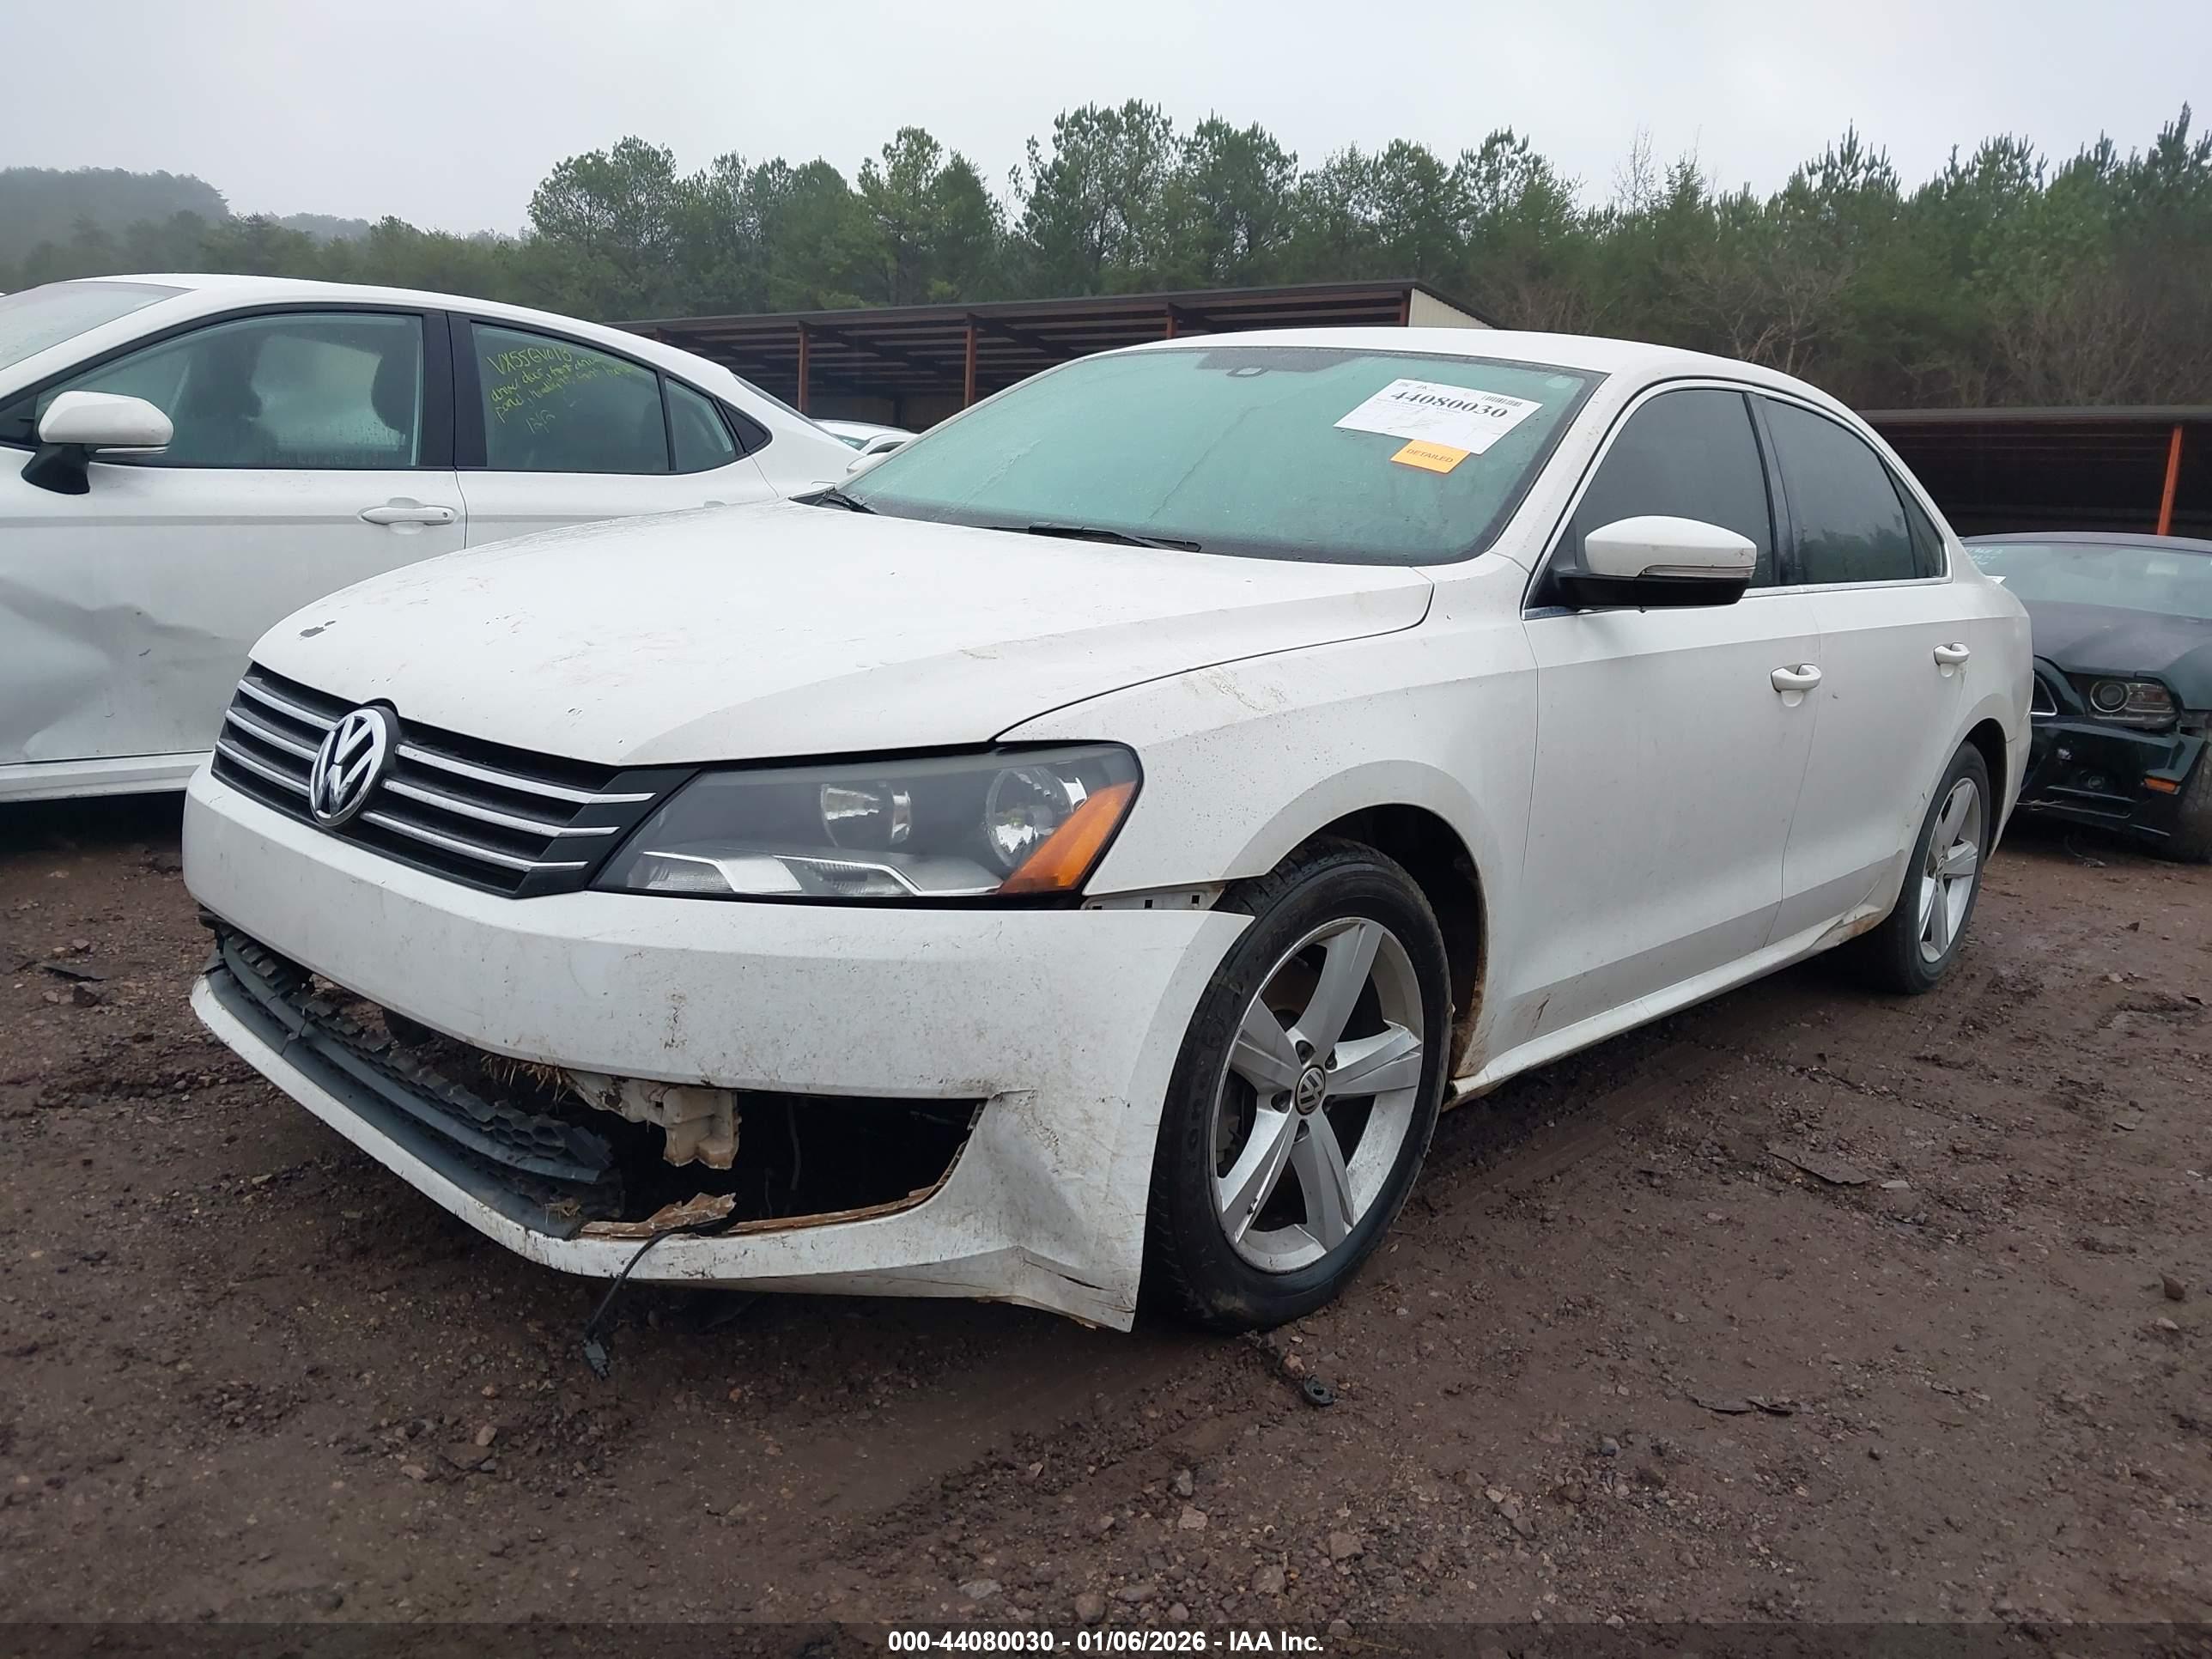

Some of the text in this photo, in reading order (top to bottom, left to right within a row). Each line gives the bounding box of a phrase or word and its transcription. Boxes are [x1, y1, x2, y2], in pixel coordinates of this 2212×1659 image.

[1390, 391, 1508, 418] 44080030
[1406, 448, 1454, 464] DETAILED
[311, 708, 386, 821] VW
